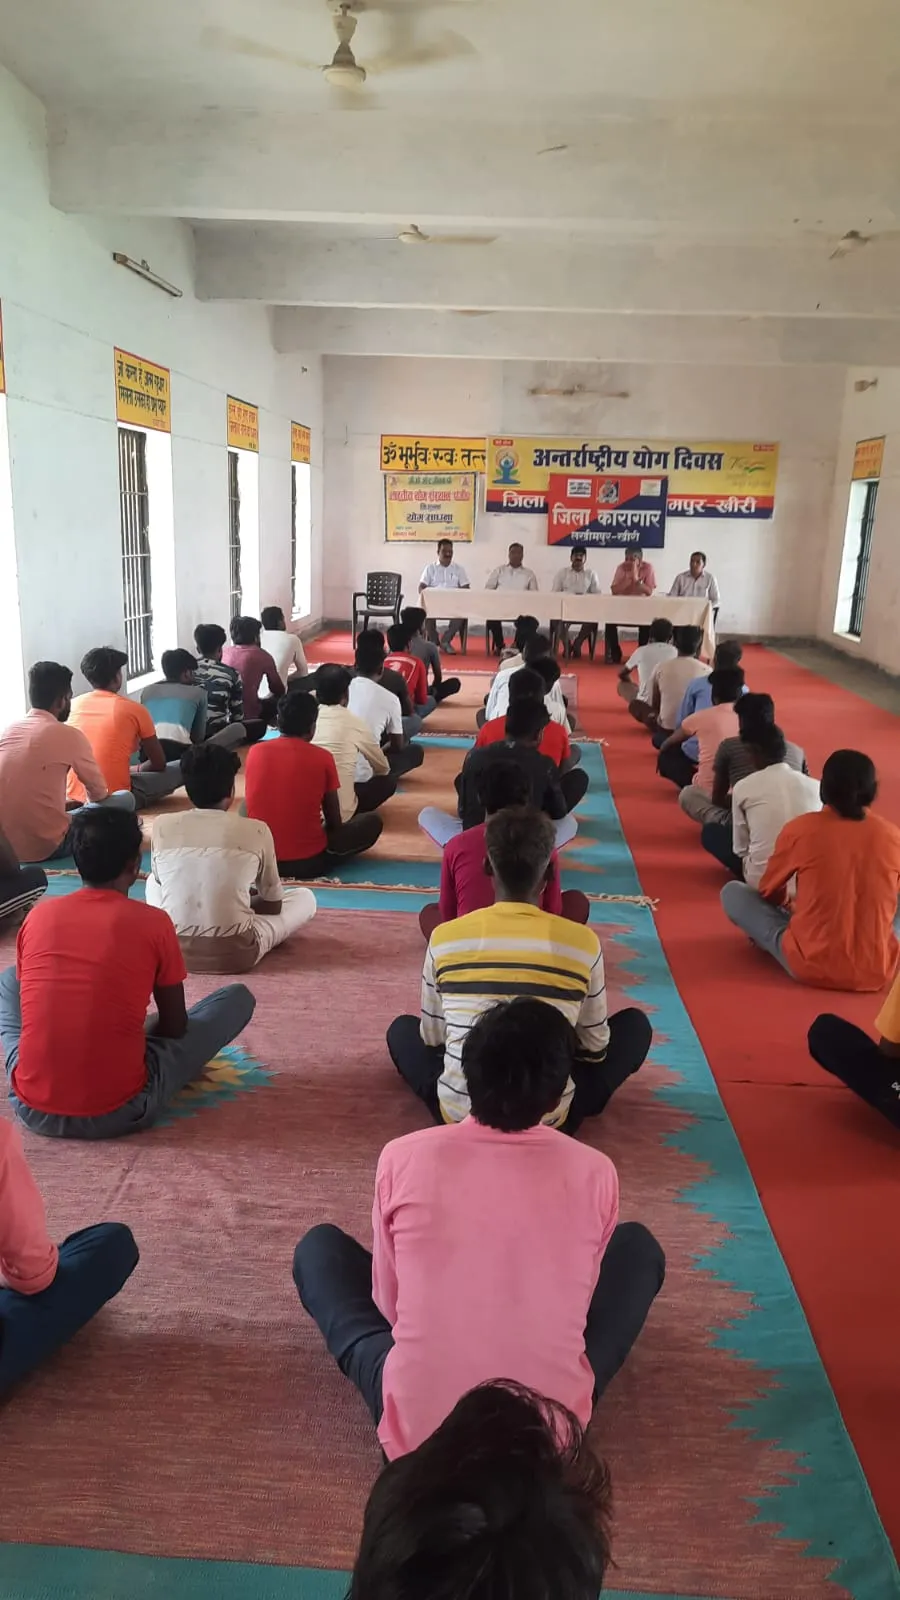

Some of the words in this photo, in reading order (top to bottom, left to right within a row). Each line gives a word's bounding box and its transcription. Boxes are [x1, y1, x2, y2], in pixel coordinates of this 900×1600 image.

[533, 443, 629, 472] अन्तर्राष्ट्रीय
[633, 446, 670, 469] योग
[674, 447, 724, 470] दिवस
[502, 491, 546, 509] जिला
[407, 512, 424, 523] योग
[552, 502, 591, 526] जिला
[597, 509, 661, 527] कारागार
